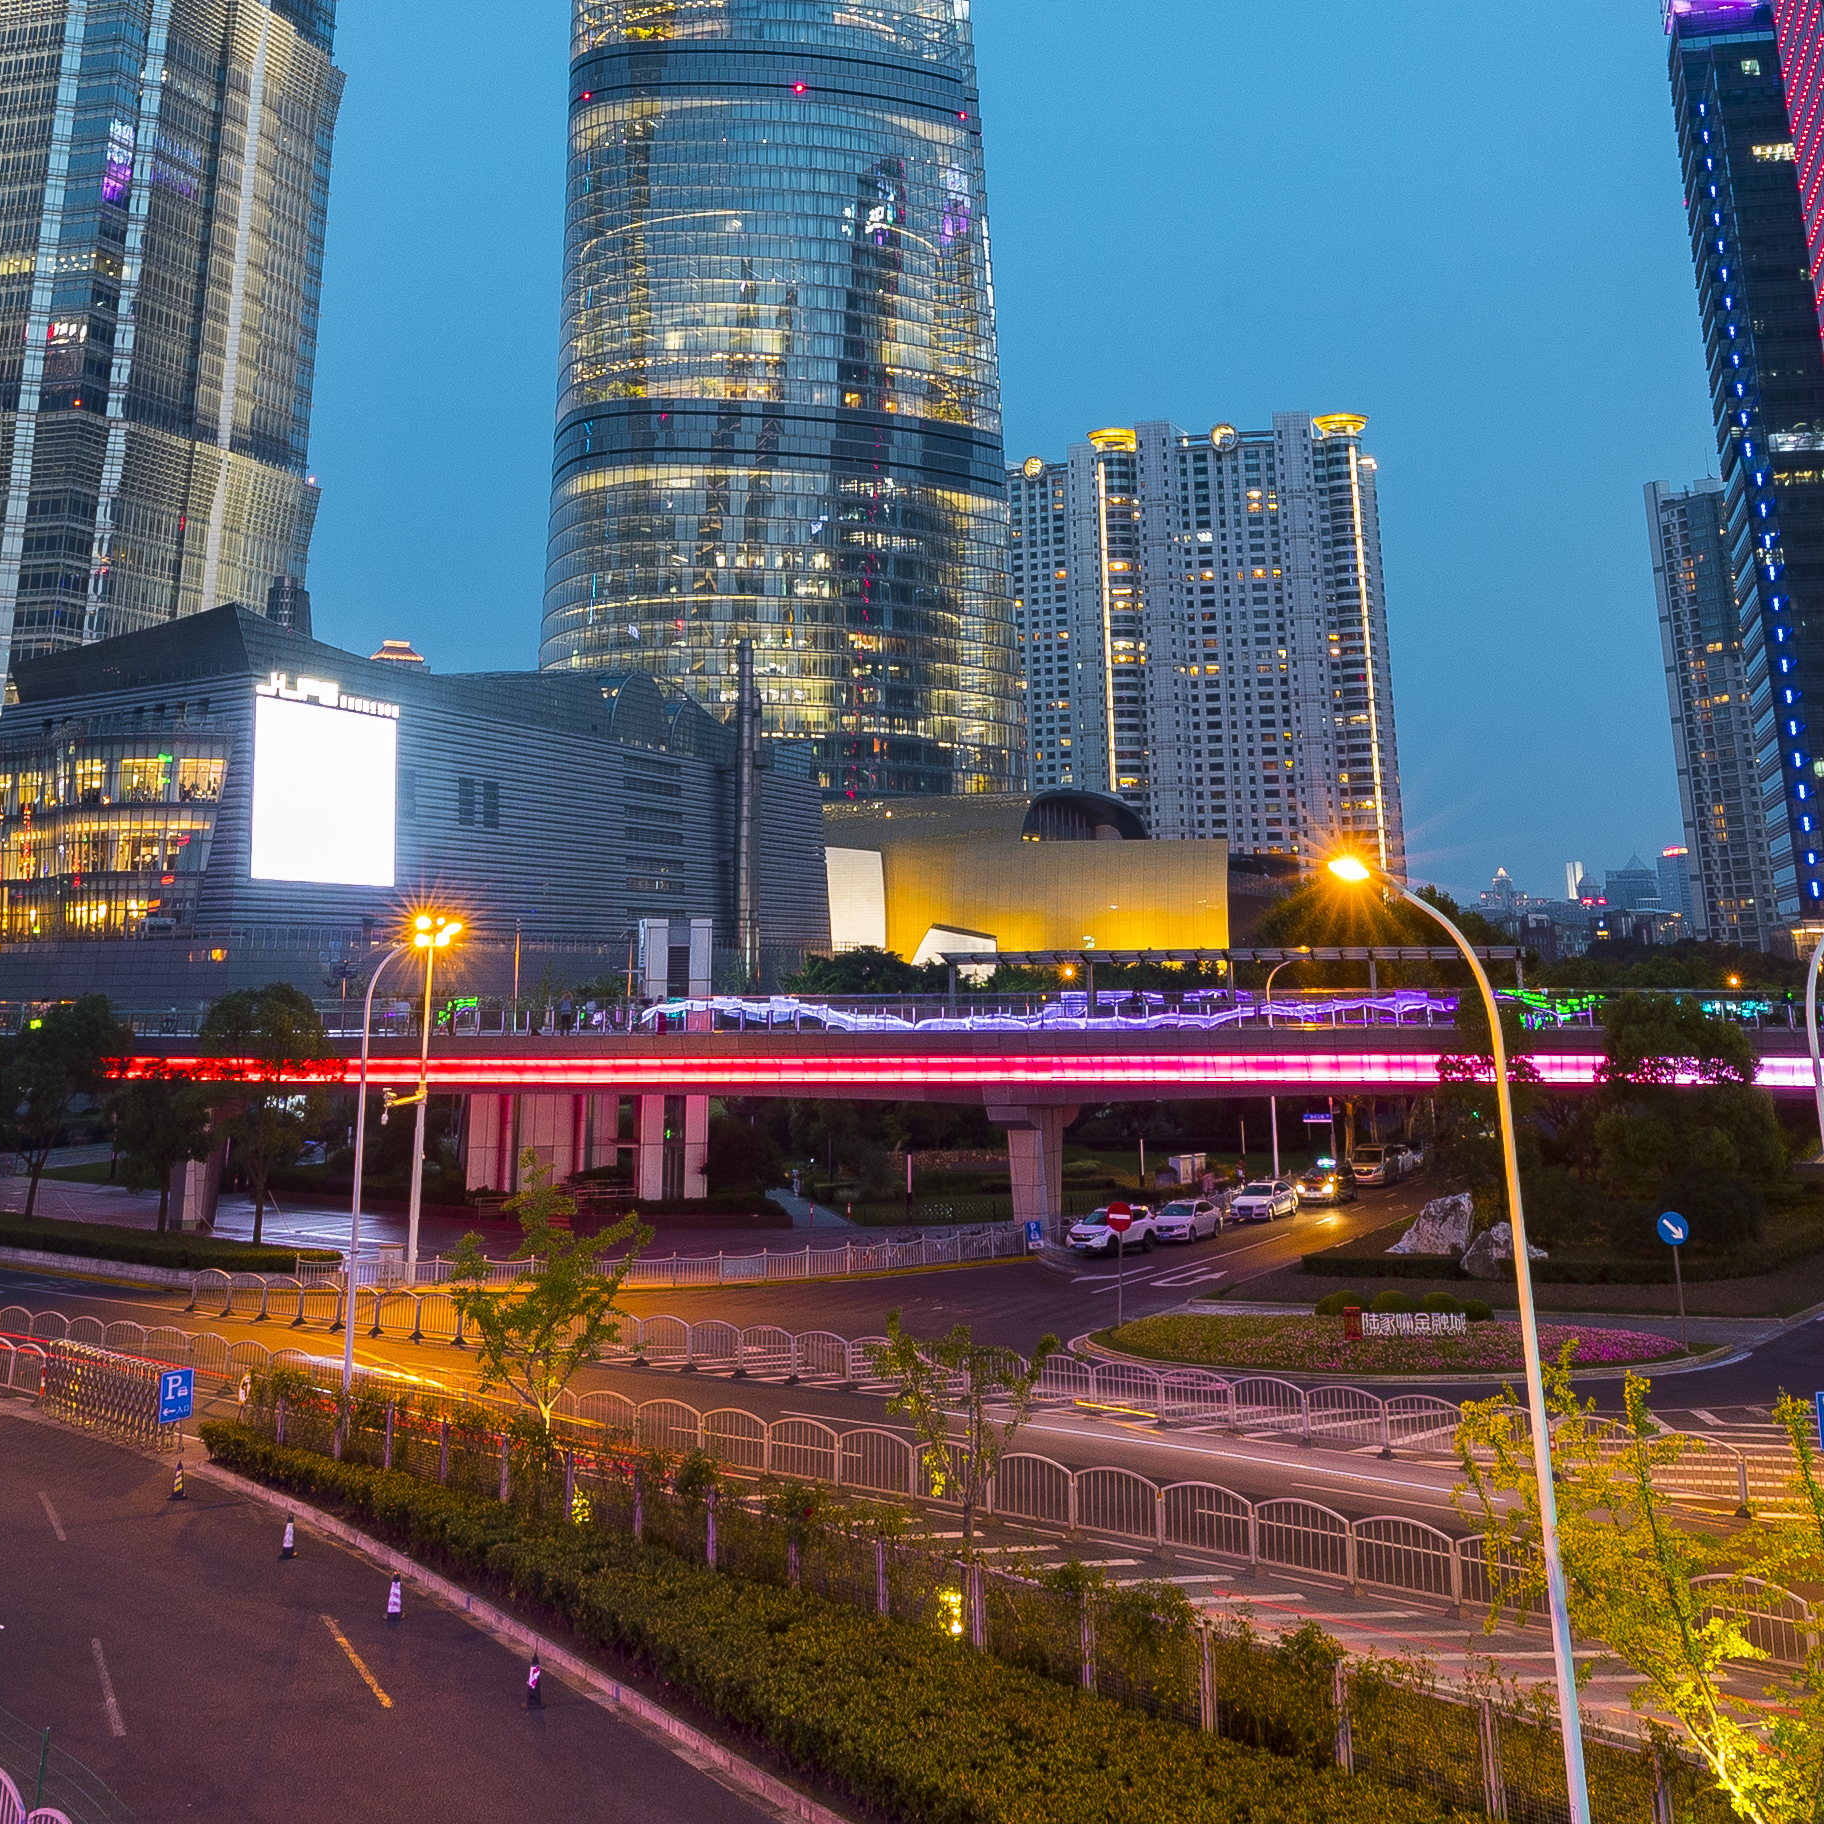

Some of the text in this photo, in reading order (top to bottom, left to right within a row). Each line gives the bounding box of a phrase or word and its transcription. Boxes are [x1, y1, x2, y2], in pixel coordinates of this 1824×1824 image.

[1361, 1312, 1466, 1332] 陆家嘴金融城
[164, 1375, 182, 1400] P
[176, 1404, 190, 1415] 入口
